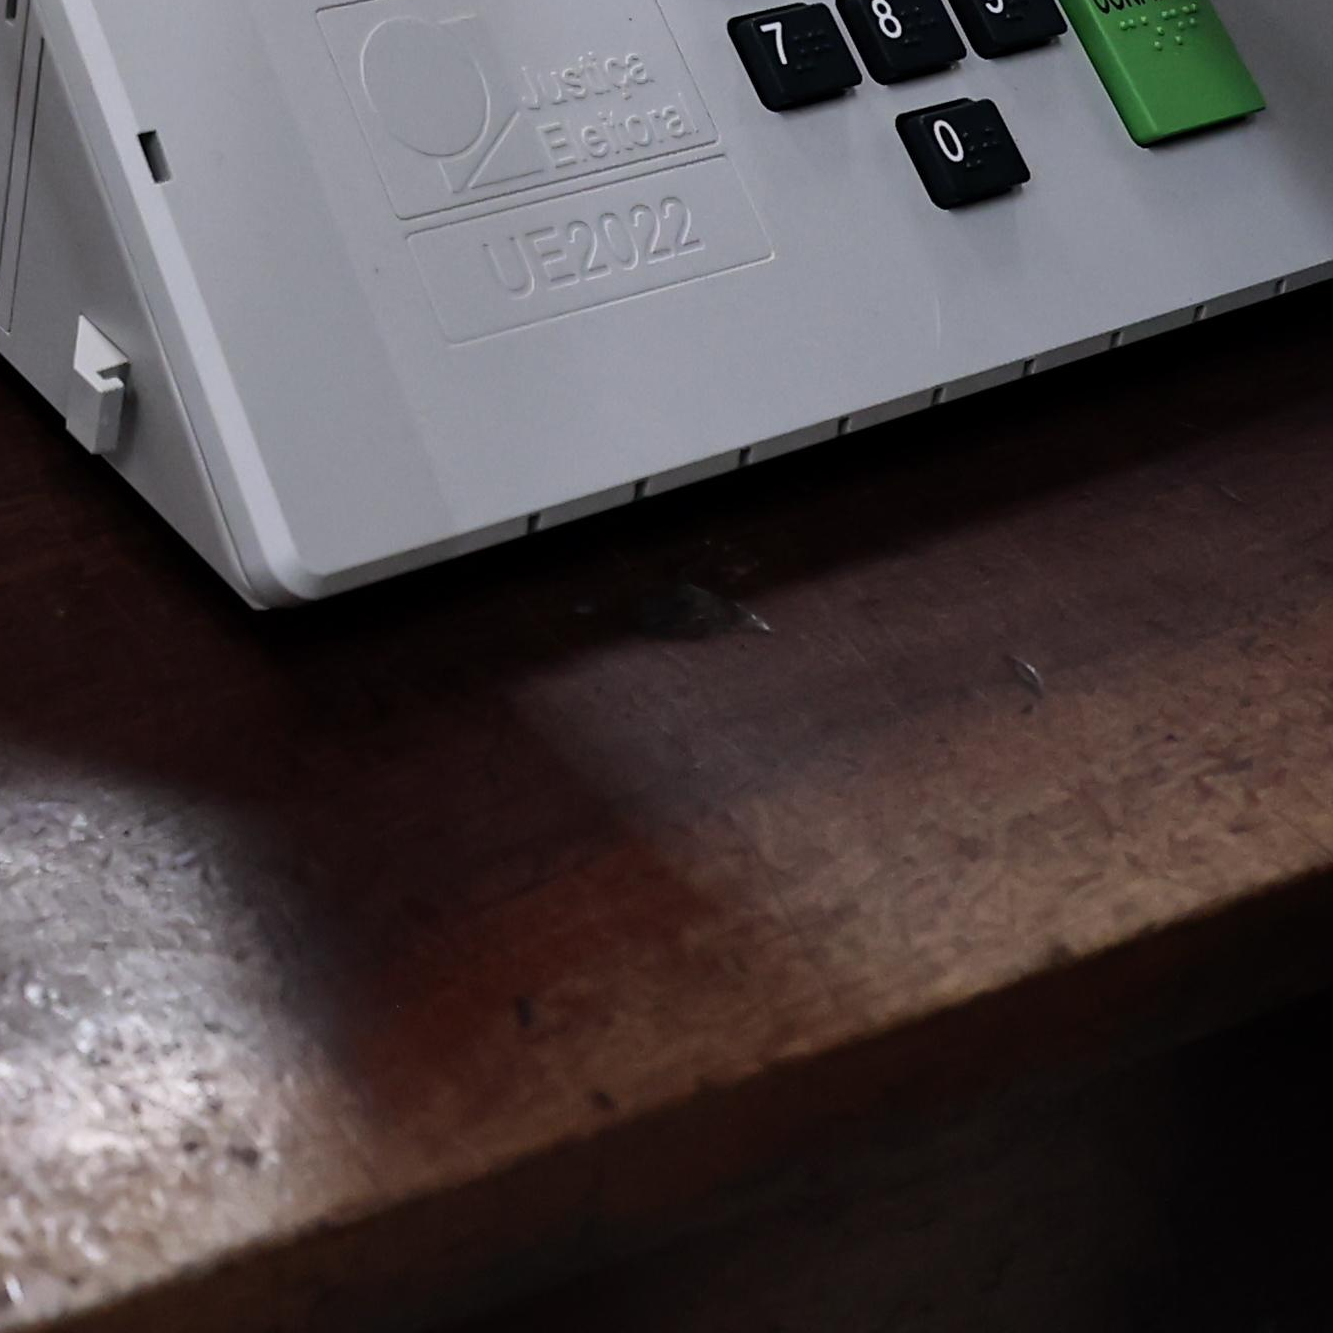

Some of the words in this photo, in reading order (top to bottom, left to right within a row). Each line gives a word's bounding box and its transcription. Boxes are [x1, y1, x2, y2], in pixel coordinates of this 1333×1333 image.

[760, 22, 791, 66] 7
[933, 119, 965, 164] 0
[482, 196, 706, 302] UE2022
